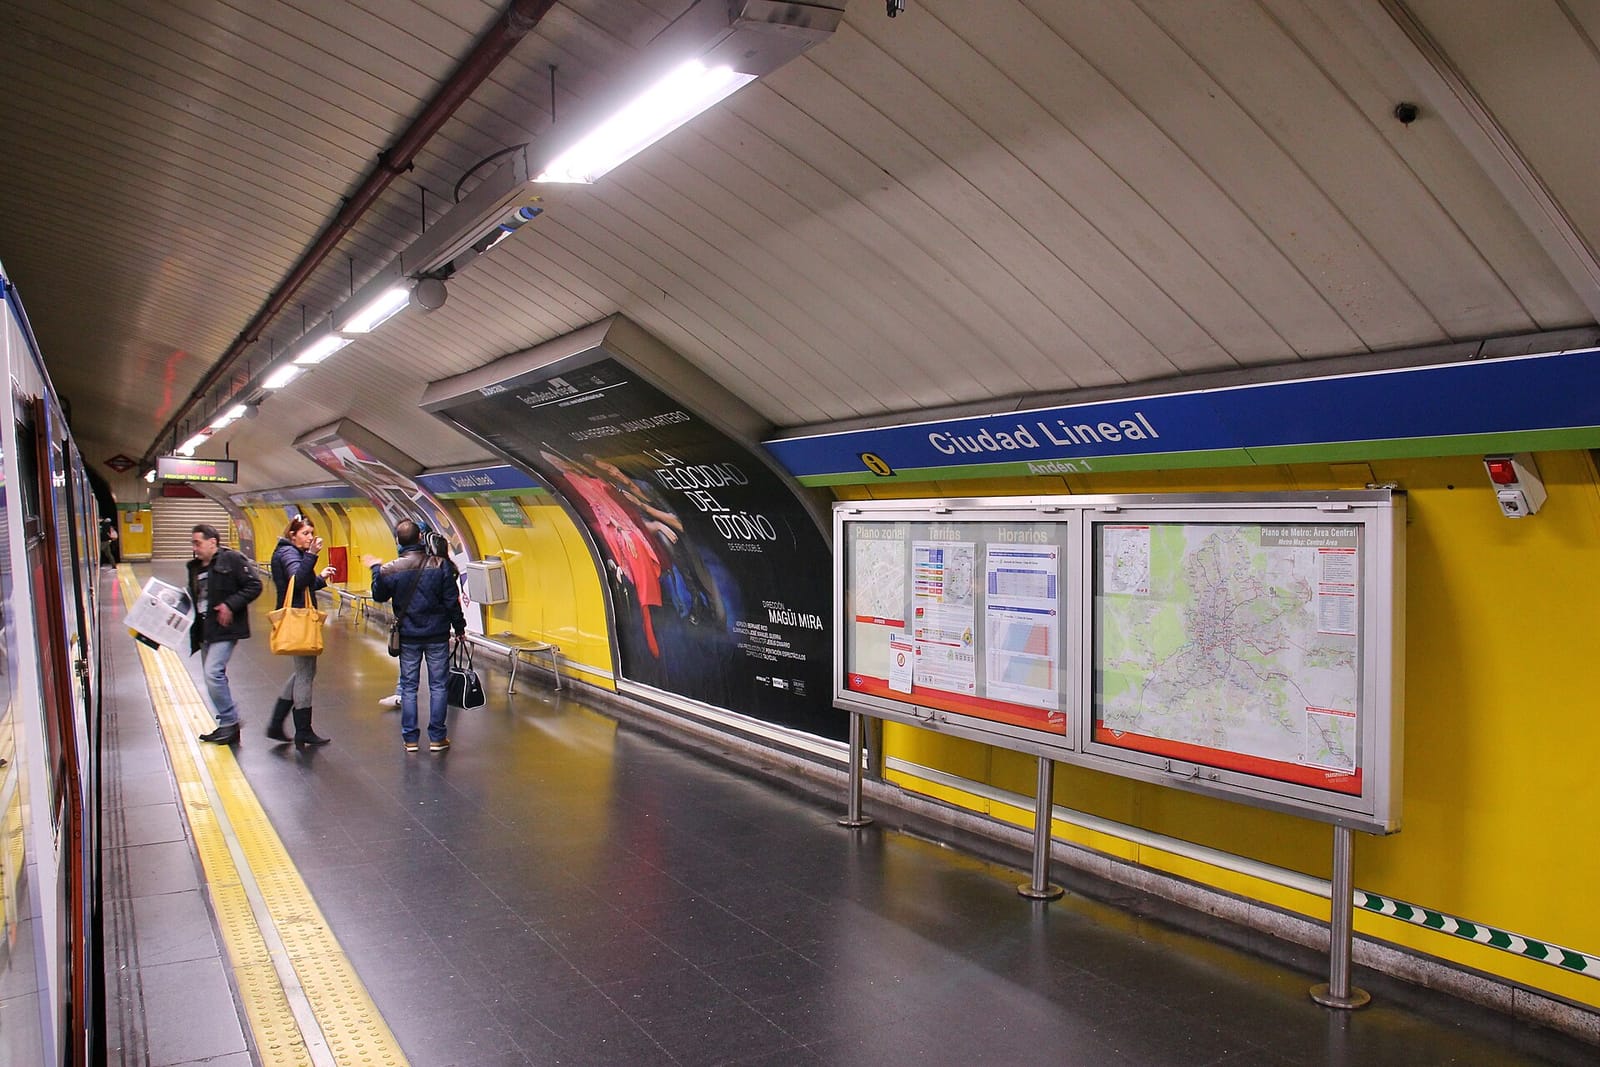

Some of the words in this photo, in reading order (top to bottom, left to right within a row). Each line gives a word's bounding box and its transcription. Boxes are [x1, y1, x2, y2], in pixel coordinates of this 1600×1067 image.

[652, 410, 691, 428] ARTERO
[928, 424, 1040, 455] Ciudad
[1036, 412, 1160, 447] Lineal
[643, 448, 684, 466] LA
[655, 463, 748, 490] VELOCIDAD
[1026, 461, 1077, 475] Andén
[1080, 460, 1092, 471] 1
[450, 475, 475, 487] Ciudad
[469, 473, 495, 486] Lineal
[684, 490, 730, 512] DEL
[711, 510, 777, 541] OTOÑO
[856, 526, 880, 539] Plano
[881, 527, 905, 540] zonal
[928, 526, 961, 541] Tarifas
[1261, 527, 1279, 537] Plano
[1280, 527, 1289, 537] de
[1291, 527, 1312, 537] Metro:
[1313, 526, 1329, 537] Área
[1330, 527, 1356, 538] Central
[998, 527, 1048, 543] Horarios
[768, 608, 797, 626] MAGÜI
[798, 612, 824, 631] MIRA
